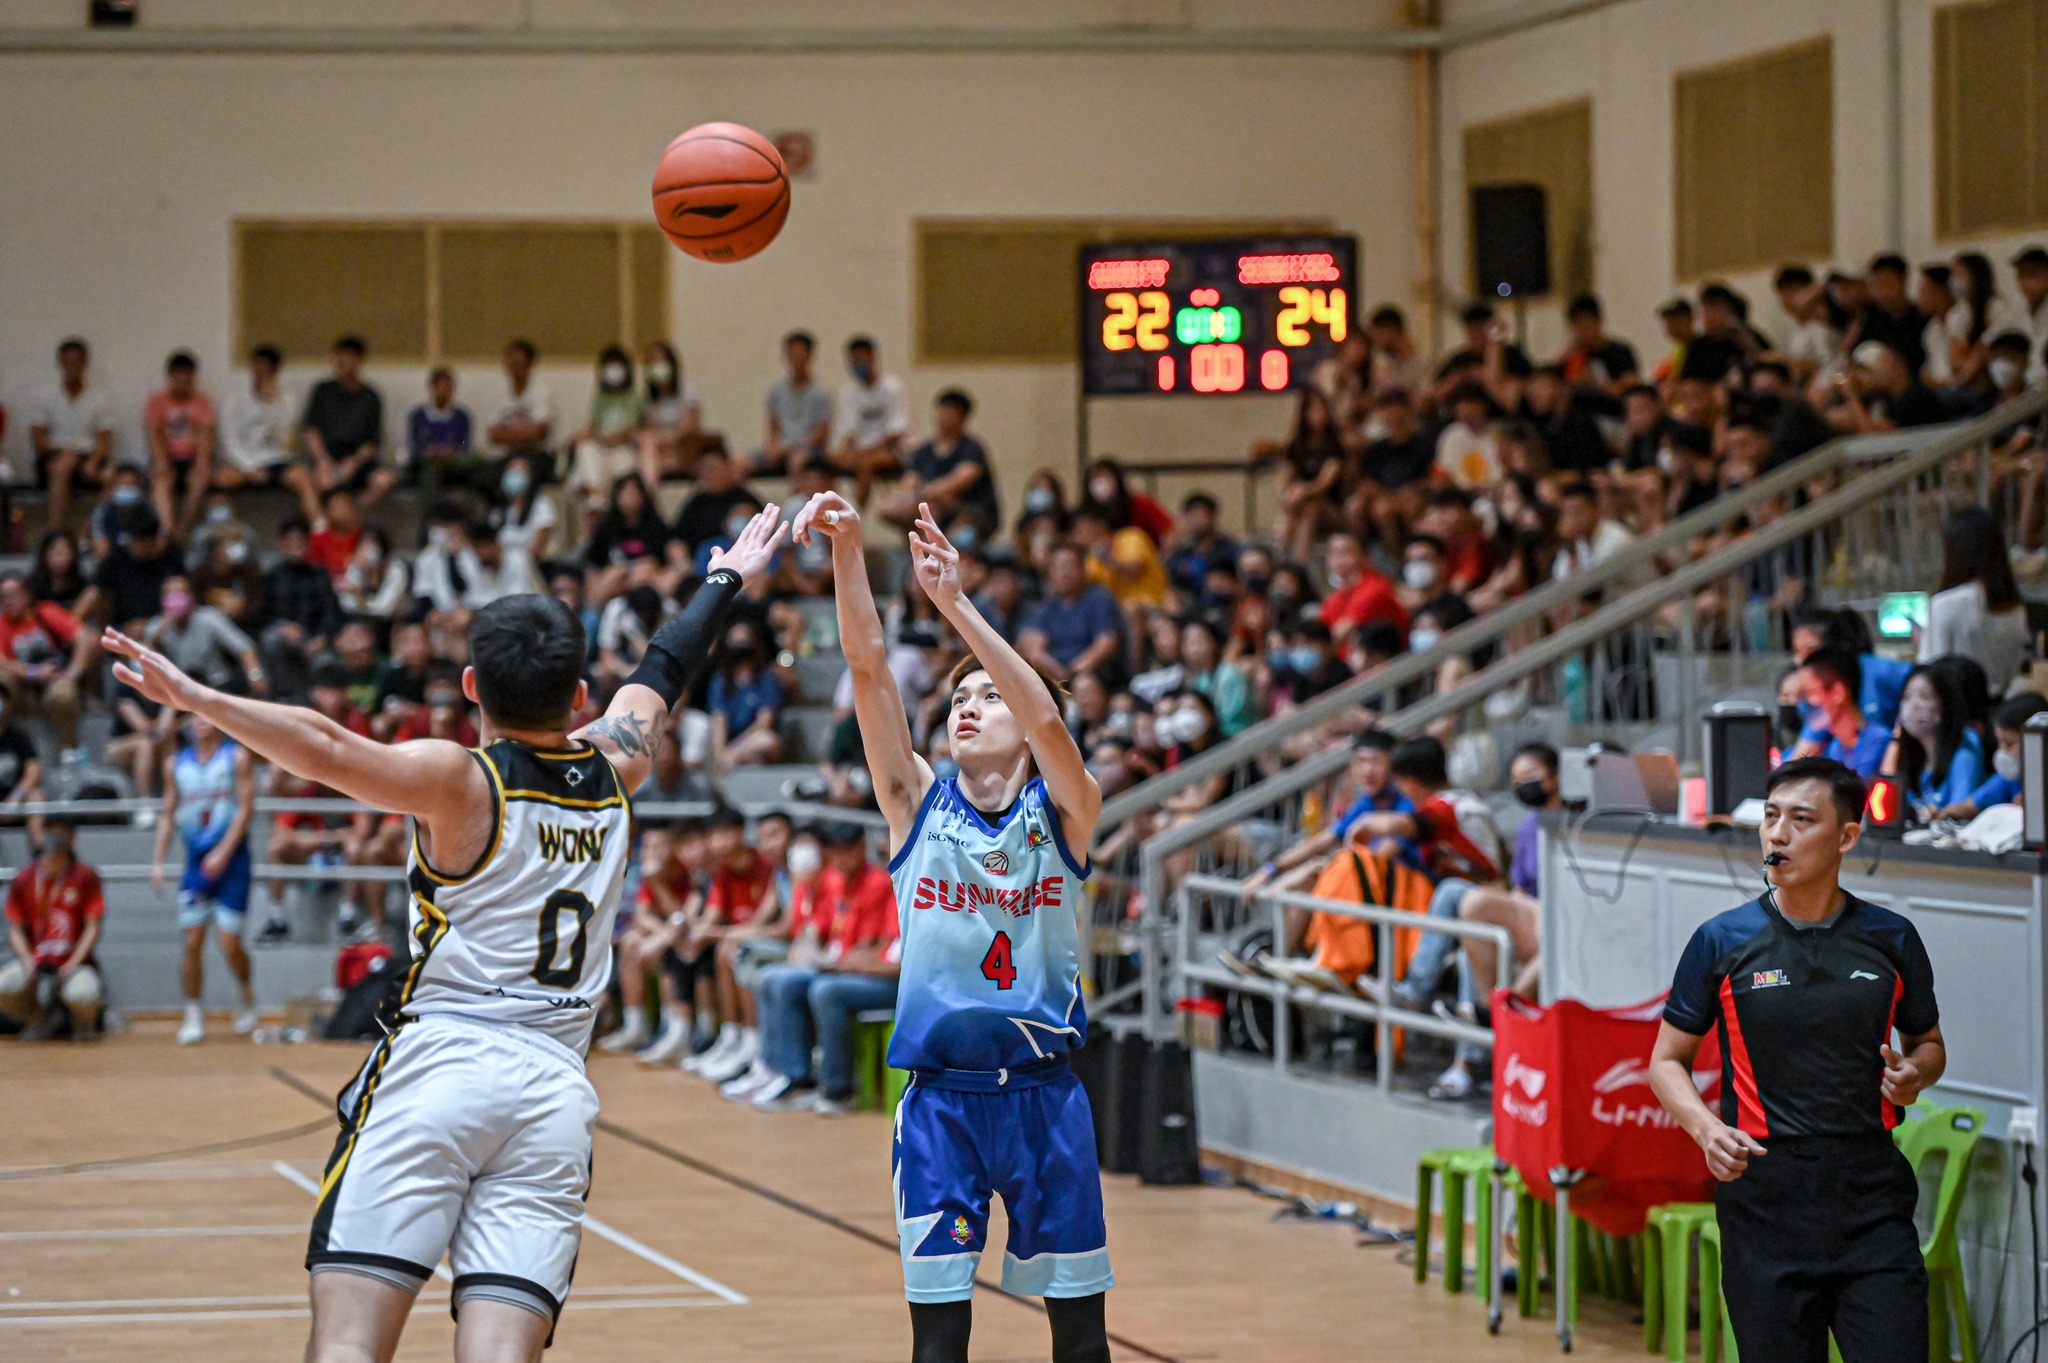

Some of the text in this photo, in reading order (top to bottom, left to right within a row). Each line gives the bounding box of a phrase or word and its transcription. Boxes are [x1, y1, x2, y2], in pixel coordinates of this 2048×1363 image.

[1103, 292, 1170, 350] 22
[1277, 286, 1346, 346] 24
[913, 876, 1064, 918] SUNRISE
[530, 889, 595, 990] 0
[980, 931, 1016, 990] 4
